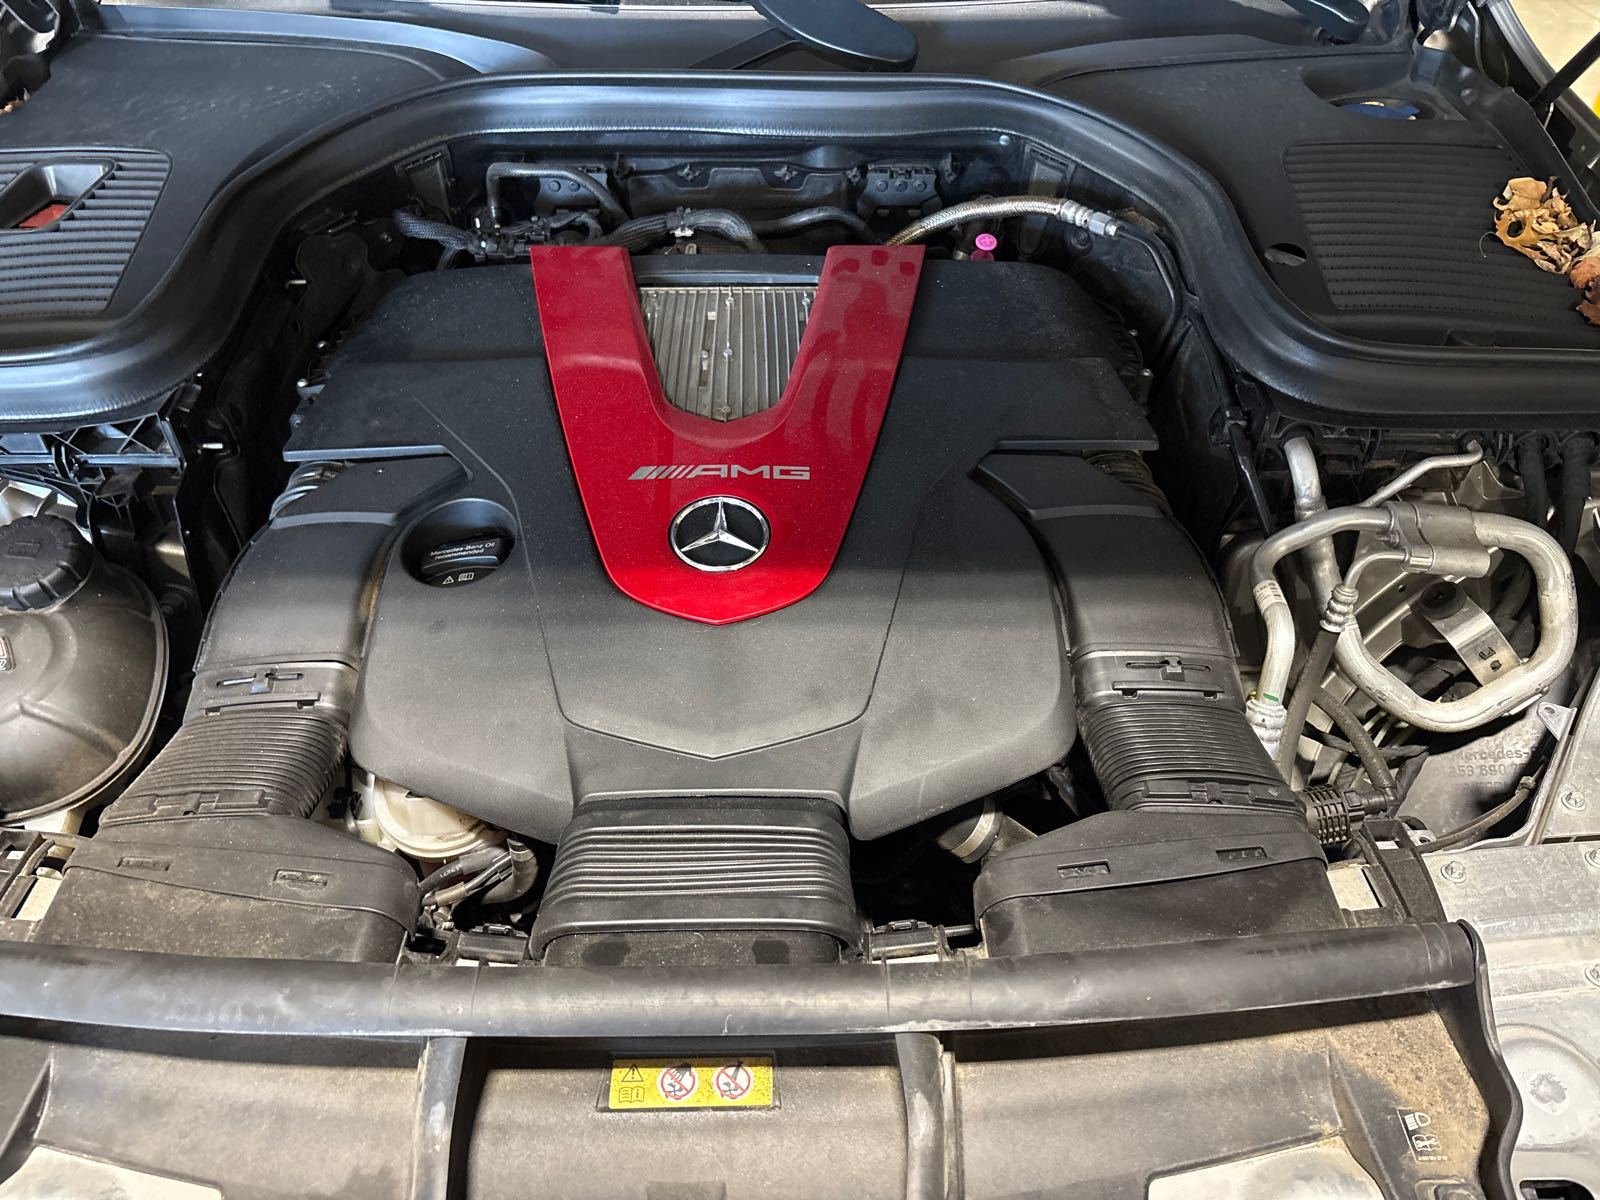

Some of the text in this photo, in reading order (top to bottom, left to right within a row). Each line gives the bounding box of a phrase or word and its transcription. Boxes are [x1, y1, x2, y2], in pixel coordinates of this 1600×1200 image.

[685, 464, 811, 480] AMG
[430, 543, 484, 557] Mercedes-Benz
[434, 548, 485, 560] recommended
